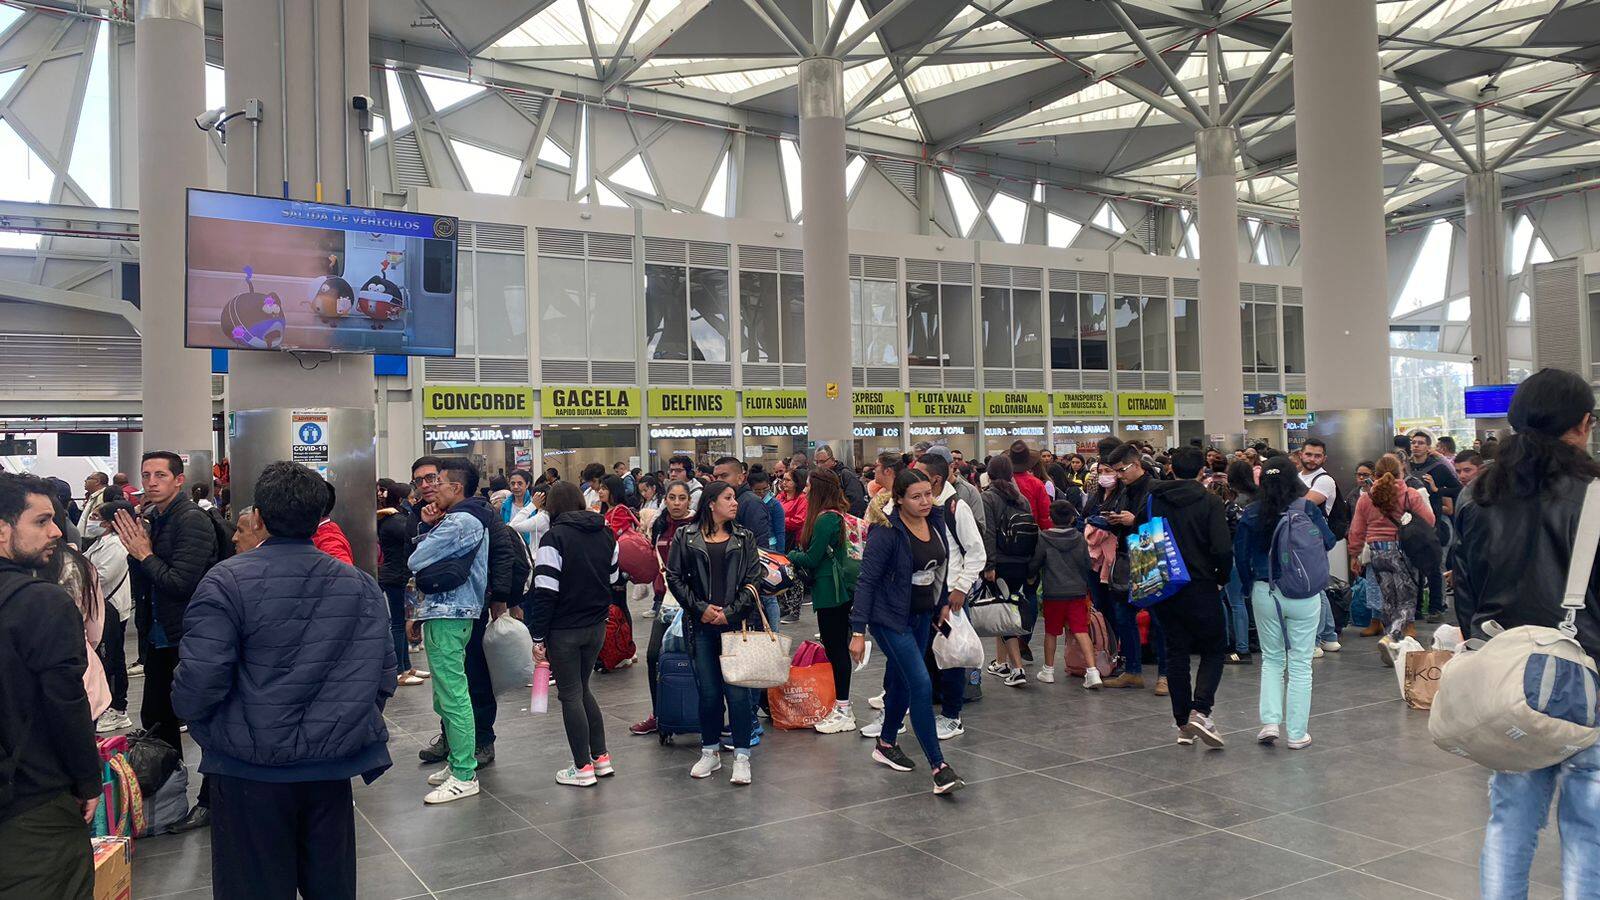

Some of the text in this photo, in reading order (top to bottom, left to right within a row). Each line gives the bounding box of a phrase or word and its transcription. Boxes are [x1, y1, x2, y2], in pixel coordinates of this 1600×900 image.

[281, 209, 420, 230] SALIDA DE VEHICULOS
[432, 392, 526, 411] CONCORDE
[553, 389, 630, 407] GACELA
[662, 394, 723, 411] DELFINES
[746, 397, 773, 409] FLOTA
[852, 392, 883, 403] EXPRESO
[918, 392, 973, 403] FLOTA VALLE
[1005, 394, 1028, 403] GRAN
[855, 404, 895, 415] PATRIOTAS
[925, 404, 966, 415] DE TENZA
[989, 404, 1044, 414] COLOMBIANA
[1127, 398, 1167, 410] CITRACOM
[555, 408, 576, 416] RAPIDO
[577, 408, 602, 416] DUITAMA
[753, 426, 789, 435] TIBANA
[883, 428, 899, 436] LOS
[943, 427, 965, 435] YOPAL
